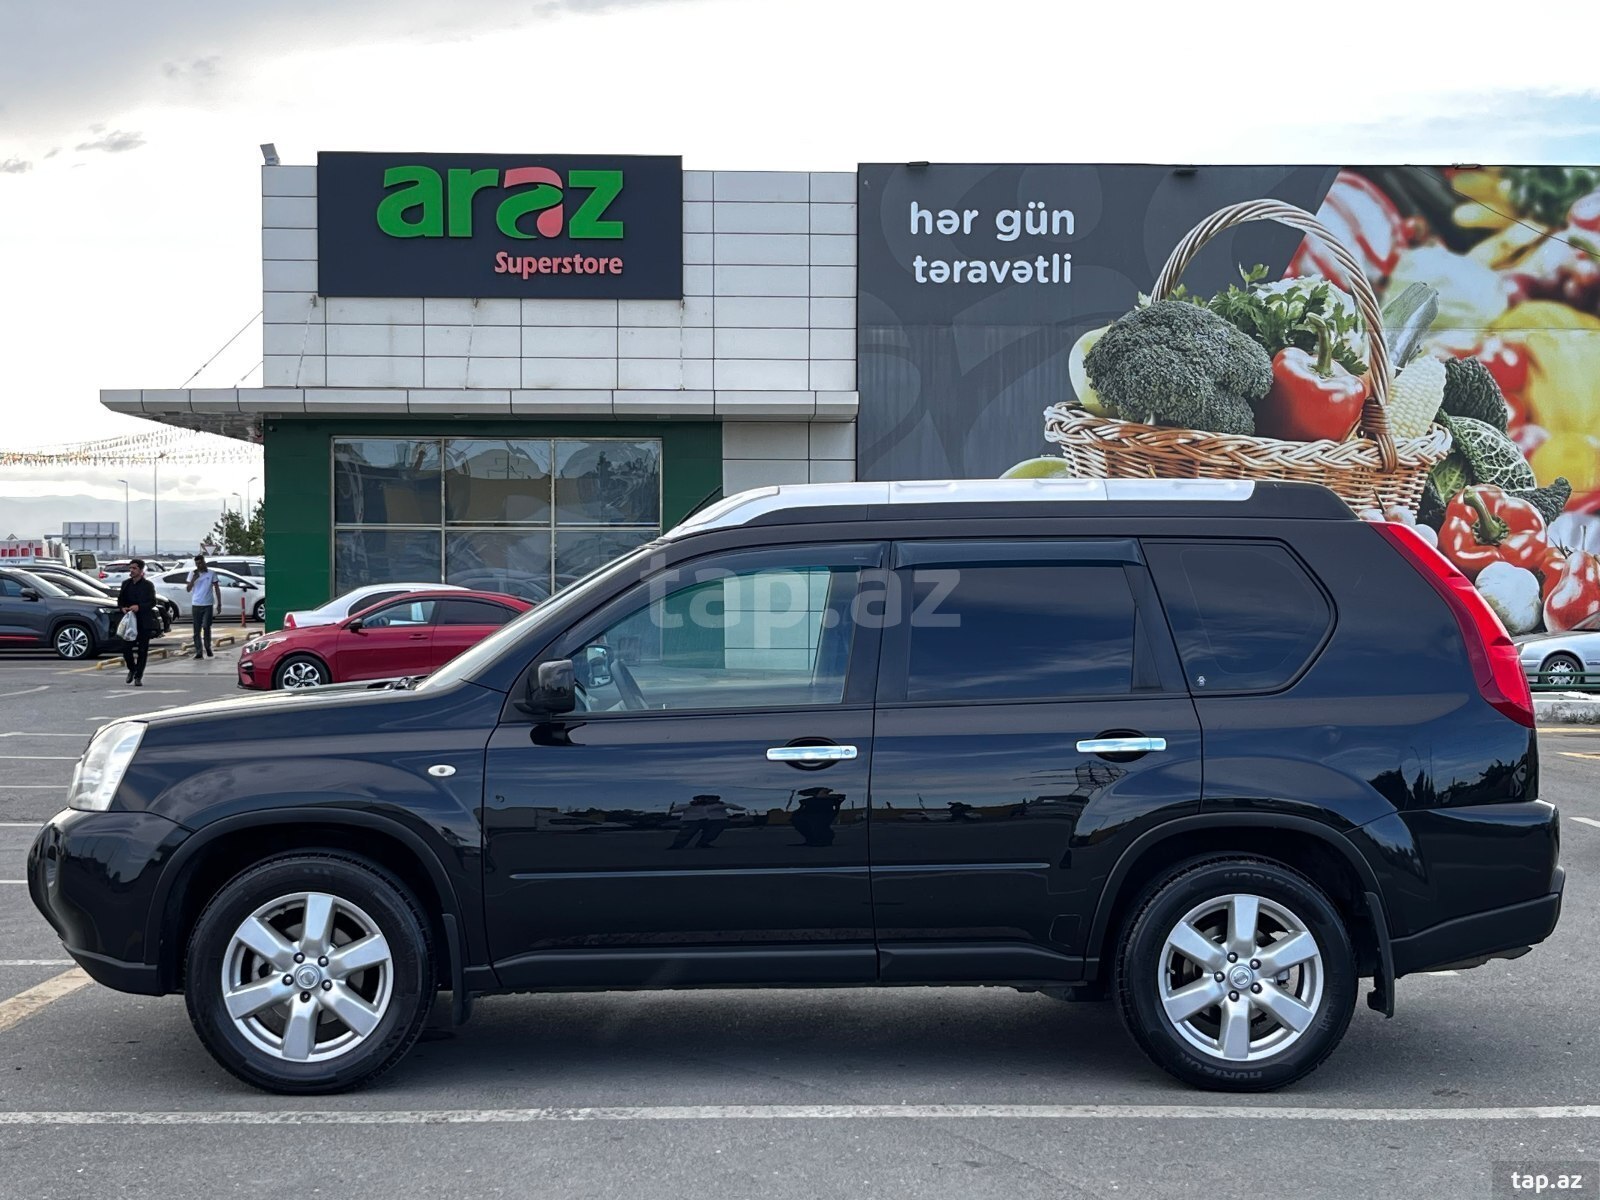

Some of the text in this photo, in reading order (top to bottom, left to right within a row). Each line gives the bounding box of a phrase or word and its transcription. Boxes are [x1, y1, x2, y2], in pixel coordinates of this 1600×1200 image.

[376, 165, 624, 239] araz
[910, 201, 1074, 241] hər gün
[494, 251, 624, 279] Superstore
[912, 253, 1072, 283] təravətli
